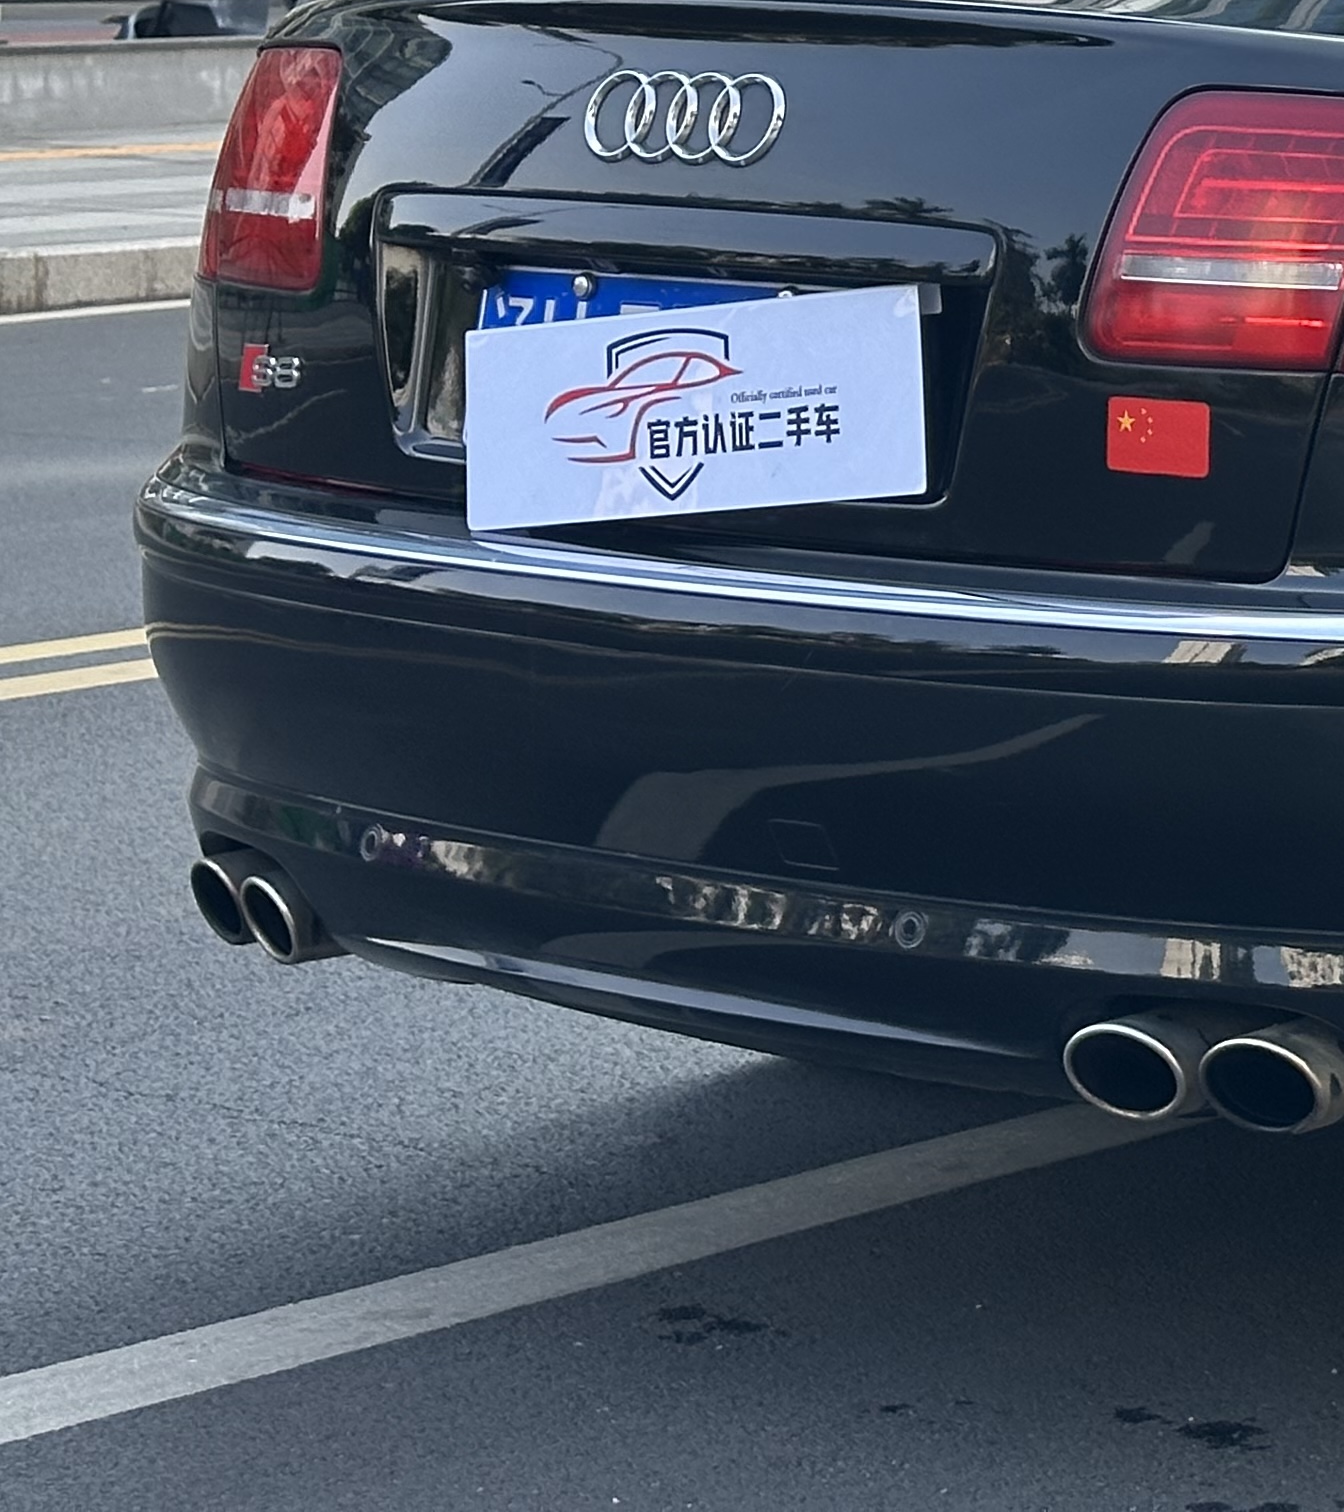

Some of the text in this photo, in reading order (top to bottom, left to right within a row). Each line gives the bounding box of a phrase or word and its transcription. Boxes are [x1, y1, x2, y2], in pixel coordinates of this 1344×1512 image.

[647, 403, 841, 460] 官方认证二手车
